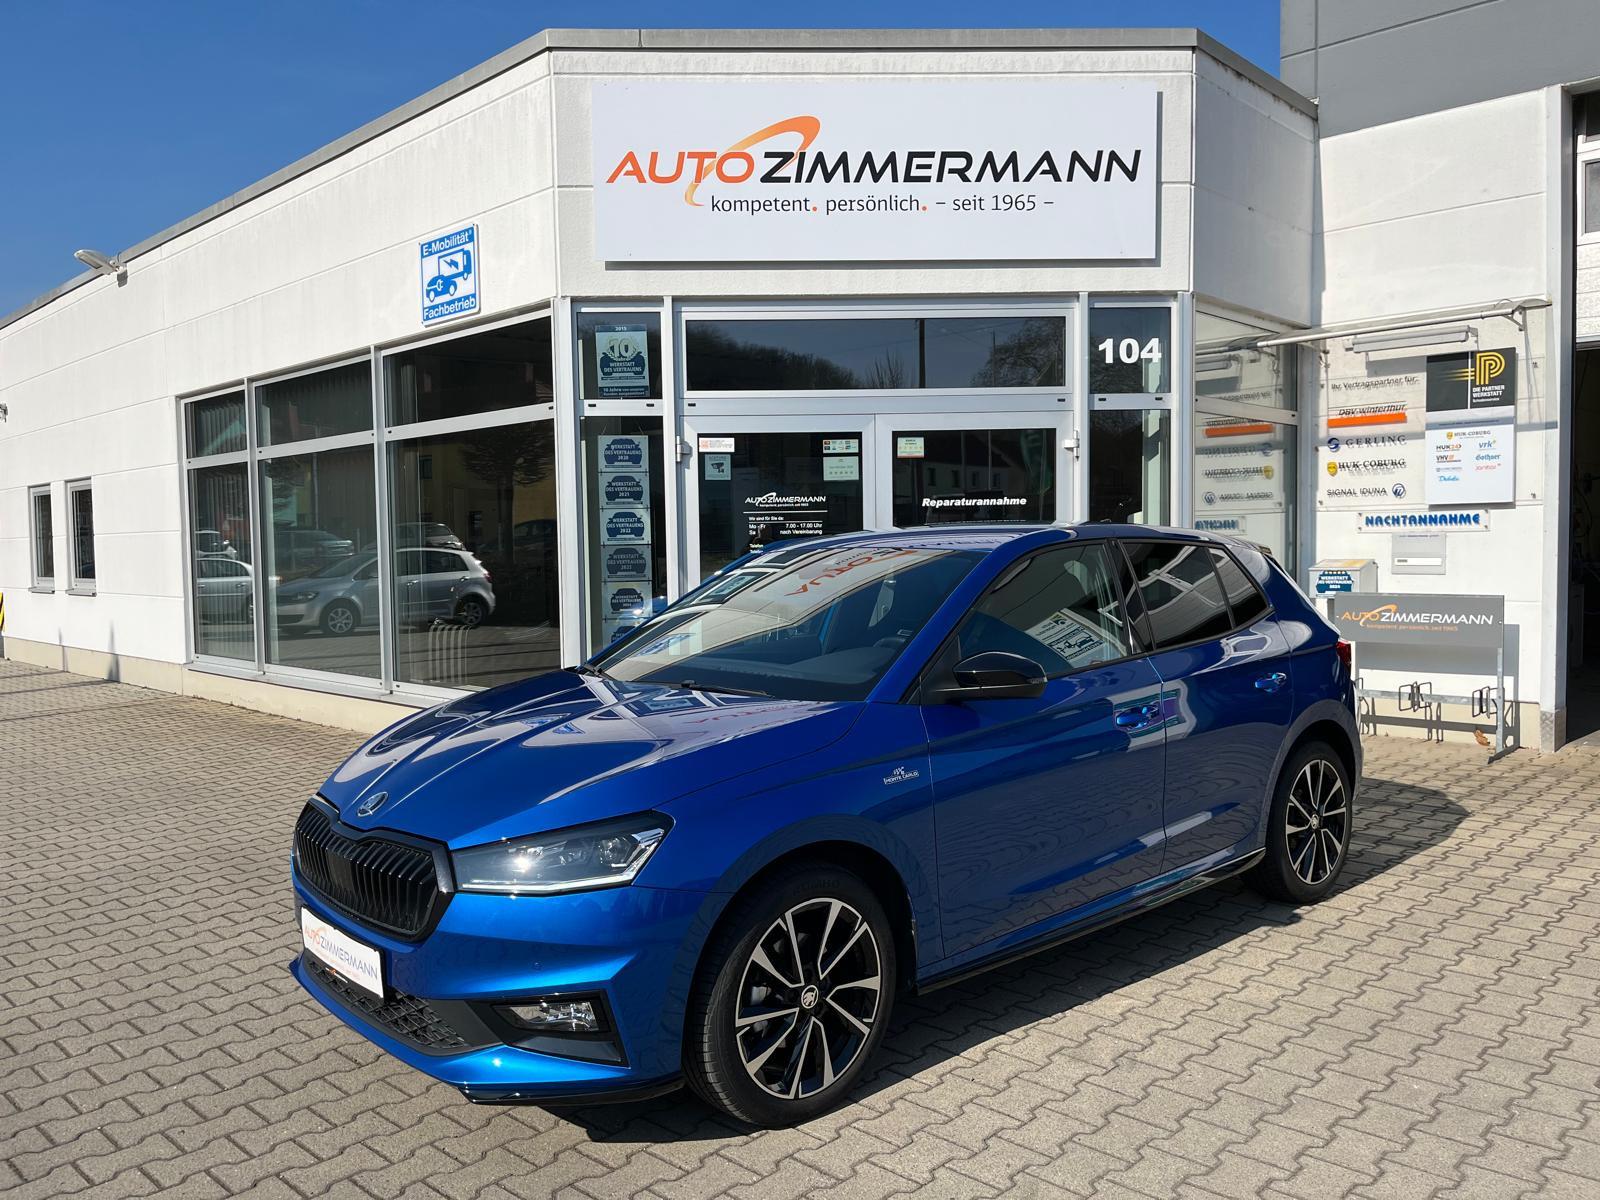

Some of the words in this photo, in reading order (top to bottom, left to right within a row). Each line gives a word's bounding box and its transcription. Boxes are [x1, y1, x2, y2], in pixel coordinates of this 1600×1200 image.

[606, 151, 755, 184] AUTO
[760, 149, 1142, 184] ZIMMERMANN
[711, 194, 818, 216] kompetent.
[826, 193, 928, 216] persönlich.
[952, 194, 985, 212] seit
[991, 194, 1037, 212] 1965
[424, 297, 476, 320] Fachbetrieb
[1098, 337, 1163, 364] 104
[1345, 434, 1406, 446] GERLING
[1338, 458, 1406, 470] HUK-COBURG
[1327, 487, 1357, 496] SIGNAL
[1359, 487, 1387, 495] IDUNA
[921, 496, 1027, 509] Reparaturannahme
[1365, 513, 1480, 527] NACHTANNAHME
[1380, 612, 1494, 625] ZIMMERMANN
